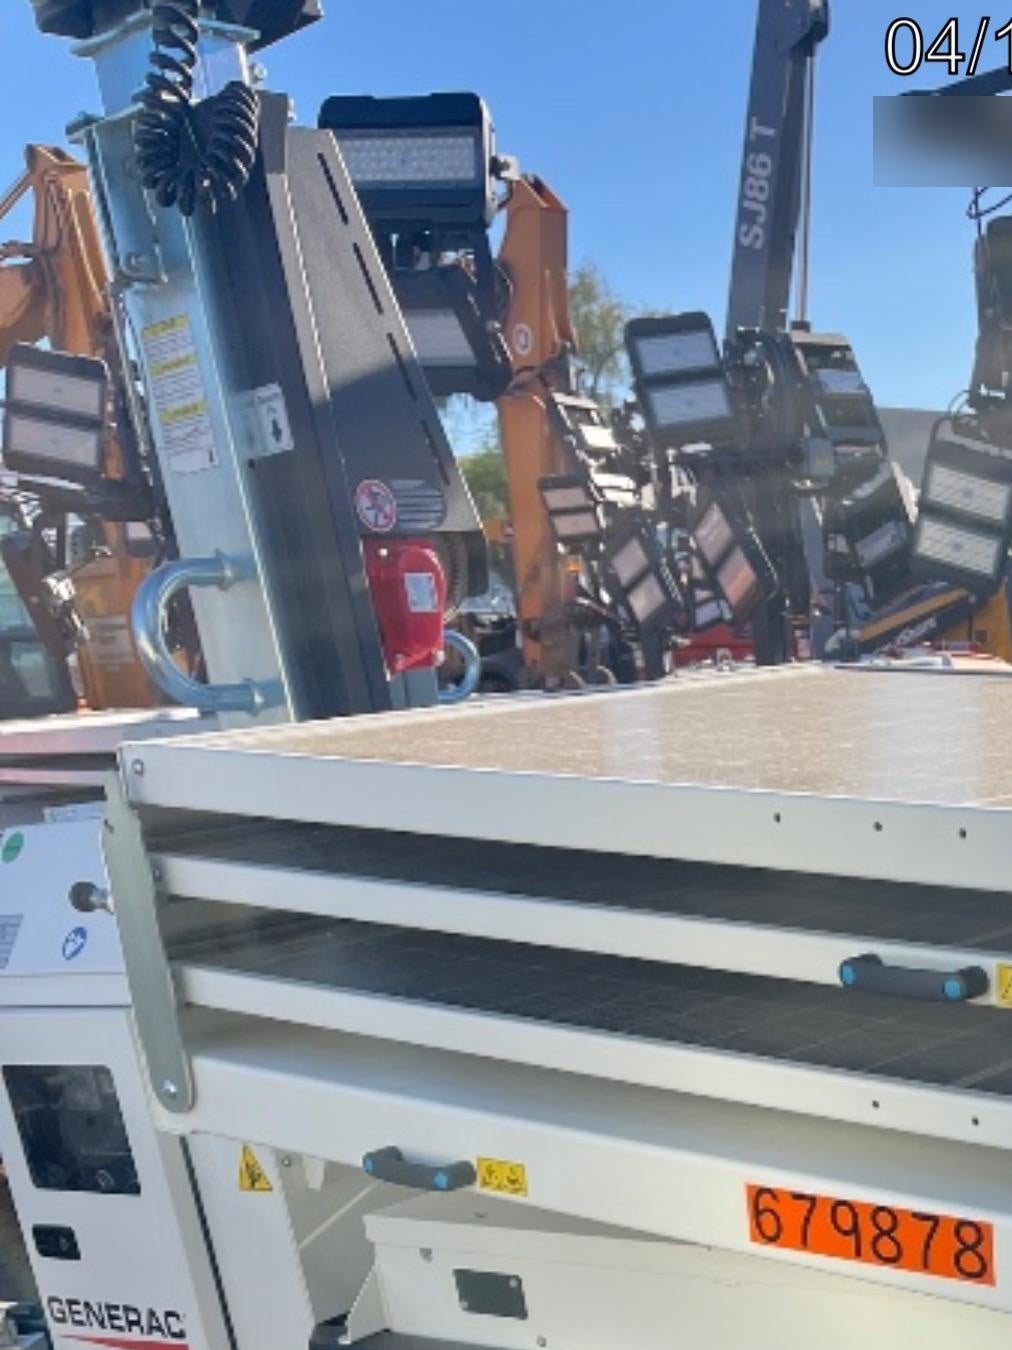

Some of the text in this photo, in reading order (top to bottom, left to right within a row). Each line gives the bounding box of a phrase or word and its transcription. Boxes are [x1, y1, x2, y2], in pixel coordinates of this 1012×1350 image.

[738, 116, 776, 249] SJ86 T
[754, 1187, 988, 1279] 679878
[47, 1295, 187, 1339] GENERAC
